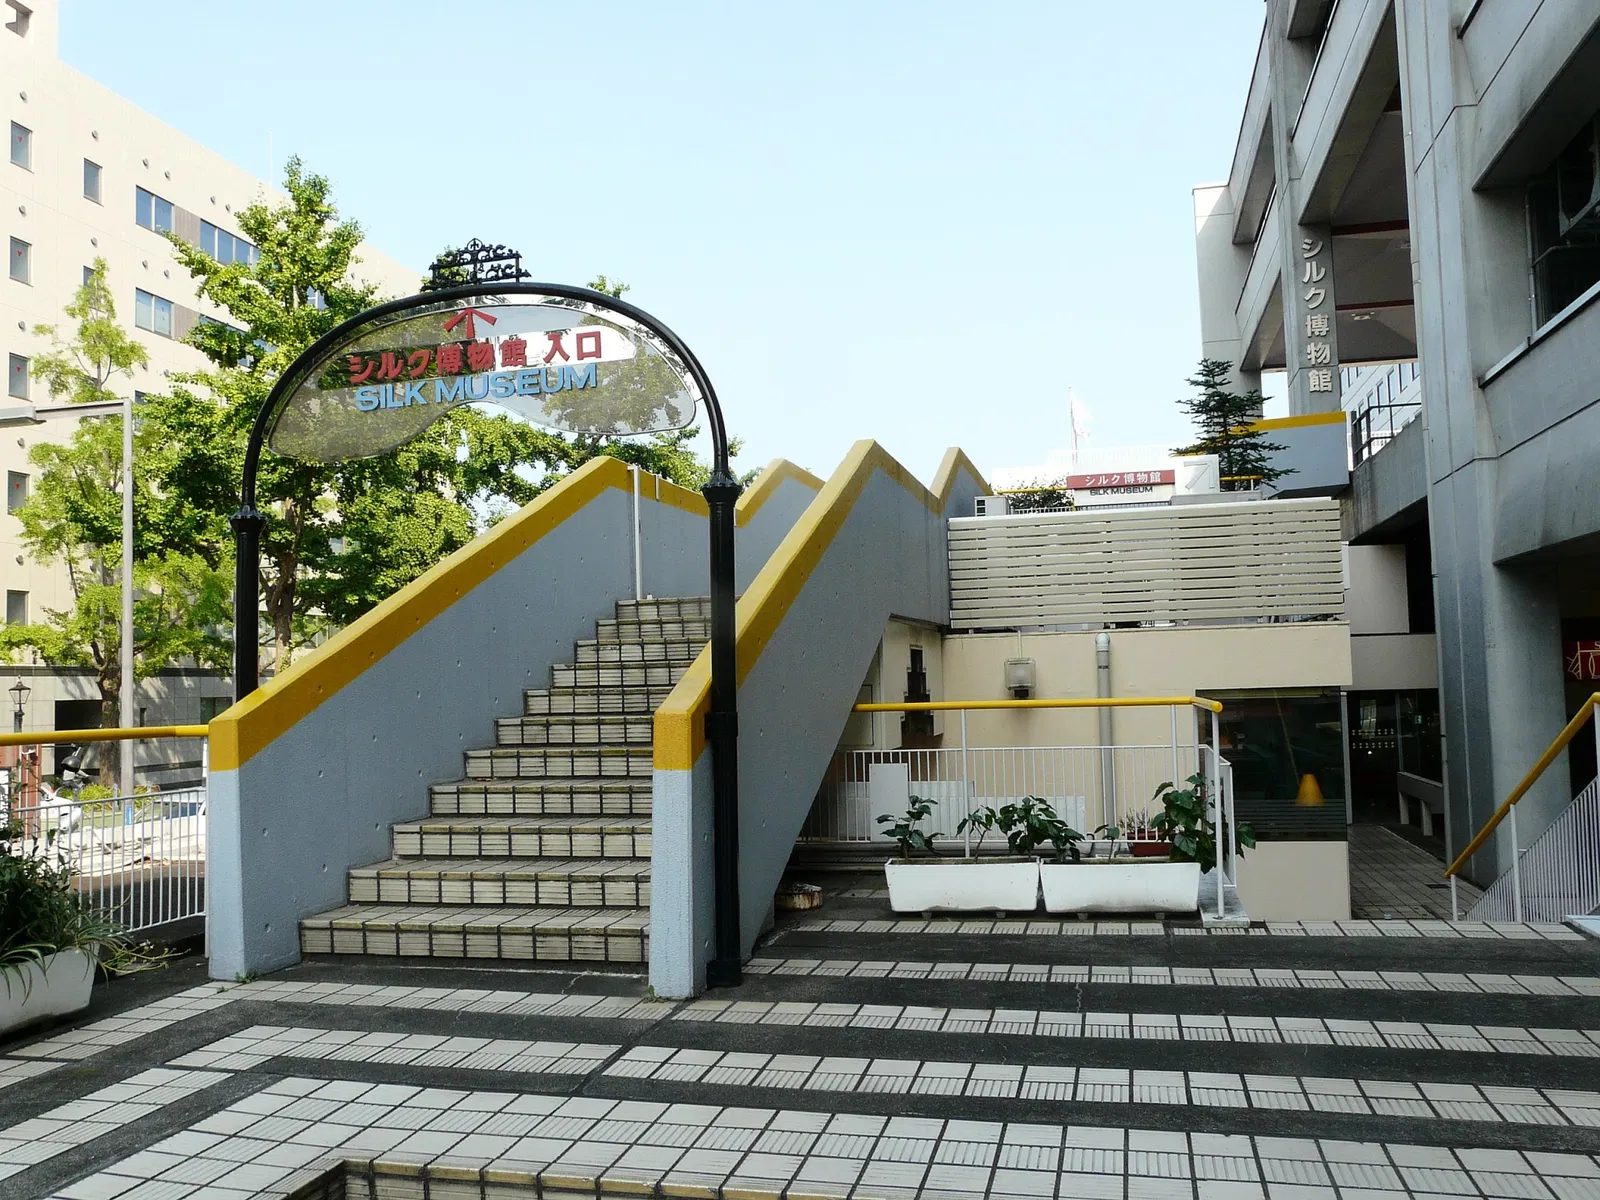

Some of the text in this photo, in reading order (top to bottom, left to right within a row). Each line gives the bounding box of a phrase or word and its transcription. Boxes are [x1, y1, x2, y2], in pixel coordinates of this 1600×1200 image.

[1302, 238, 1332, 392] シルク博物館
[349, 331, 602, 384] シルク博物館 入口
[355, 363, 598, 412] SILK MUSEUM
[1085, 472, 1161, 486] シルク博物館
[1090, 486, 1153, 496] SILK MUSEUM
